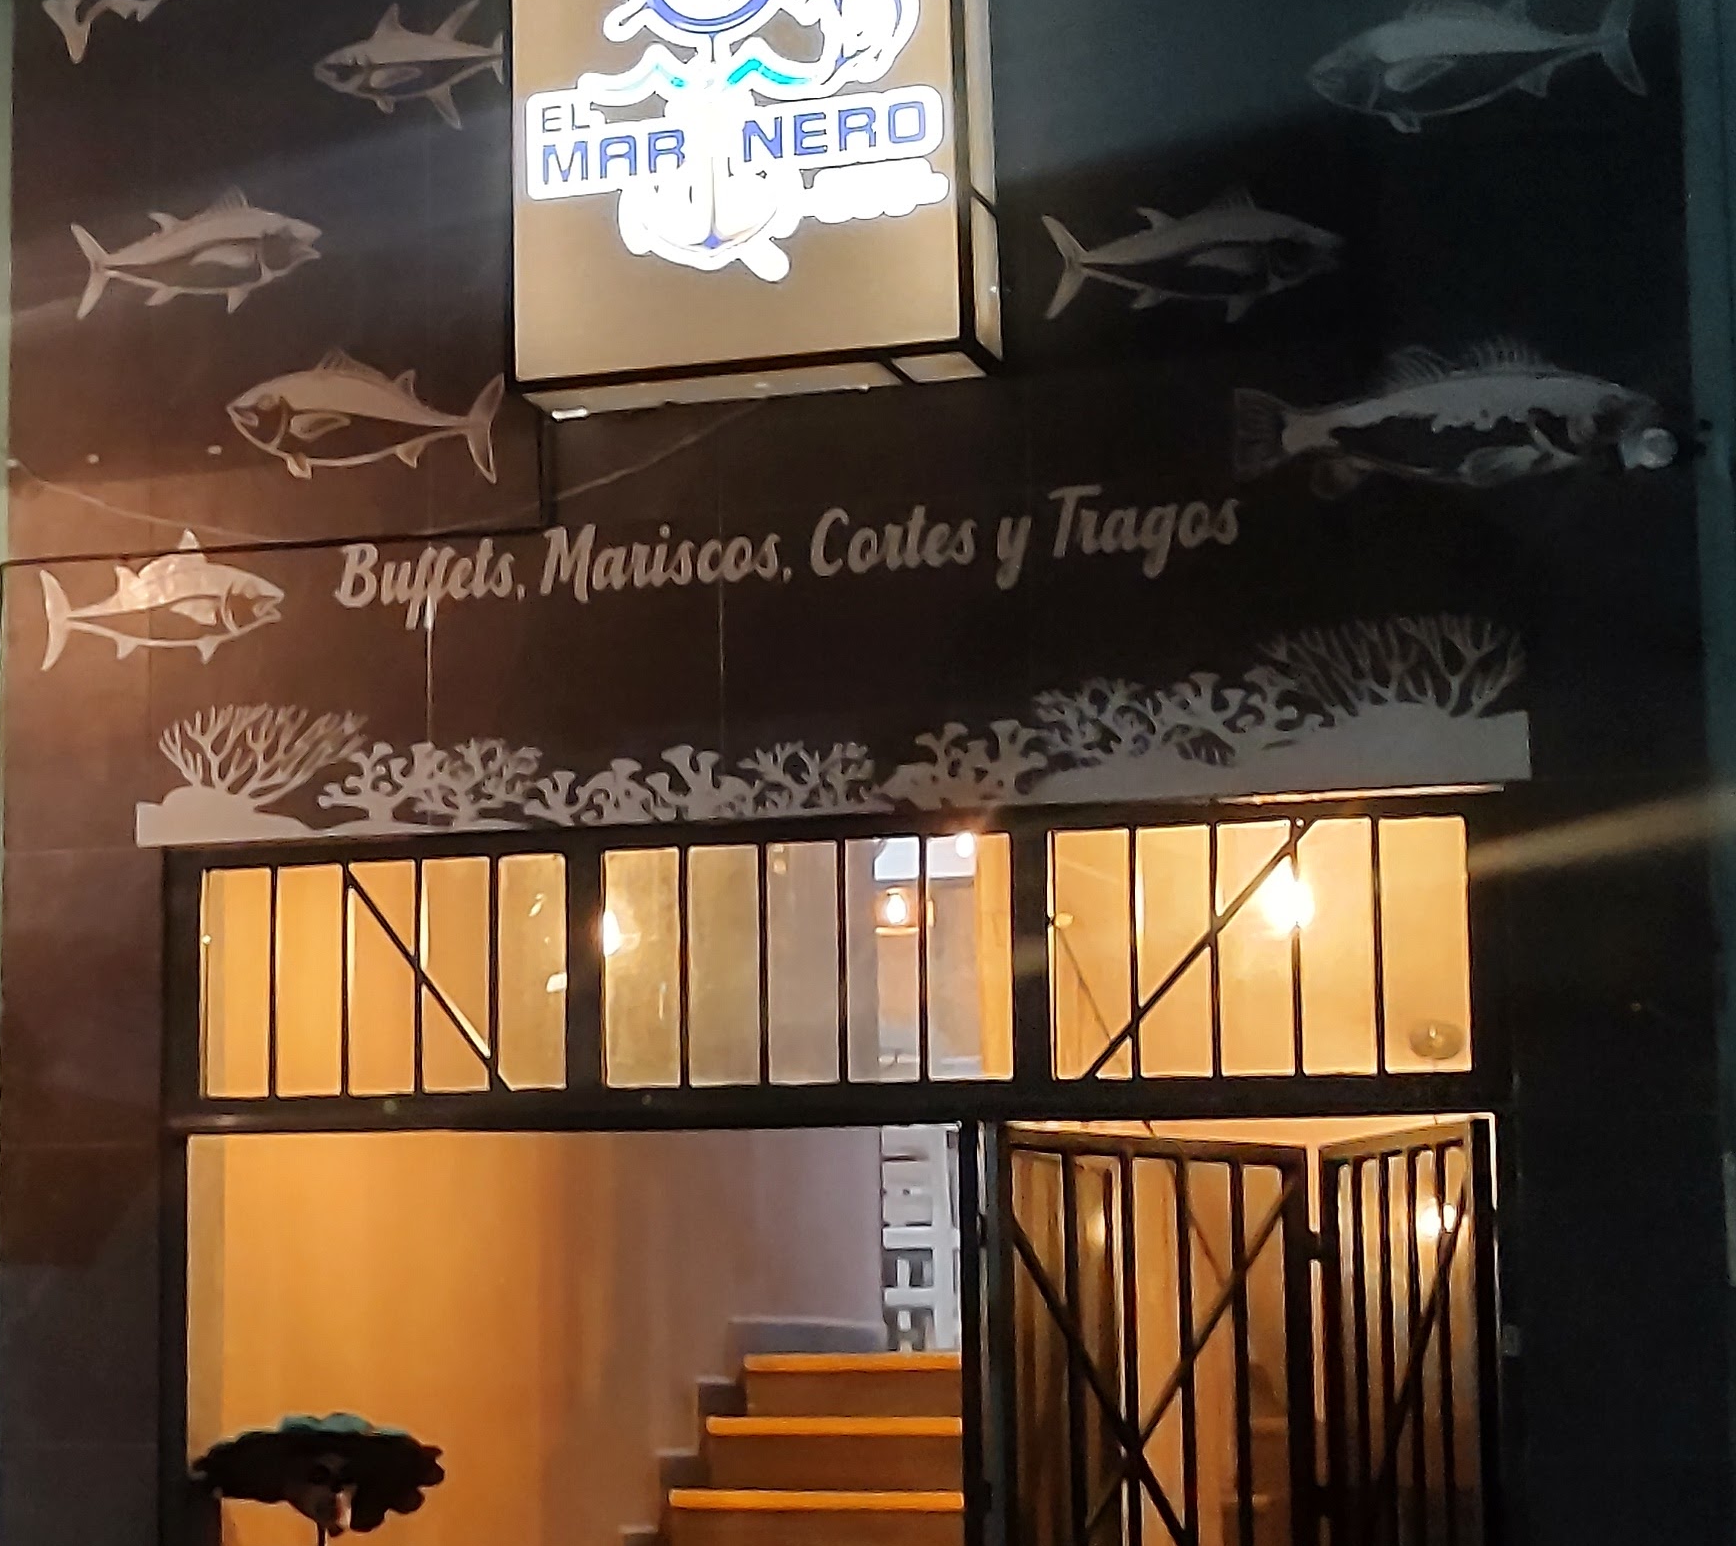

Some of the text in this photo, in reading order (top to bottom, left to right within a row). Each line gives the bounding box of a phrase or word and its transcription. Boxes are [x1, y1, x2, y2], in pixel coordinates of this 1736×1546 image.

[541, 102, 591, 134] EL
[541, 100, 927, 185] MARNERO
[334, 484, 1240, 631] Buffets, Mariscos, Cortes y Tragos
